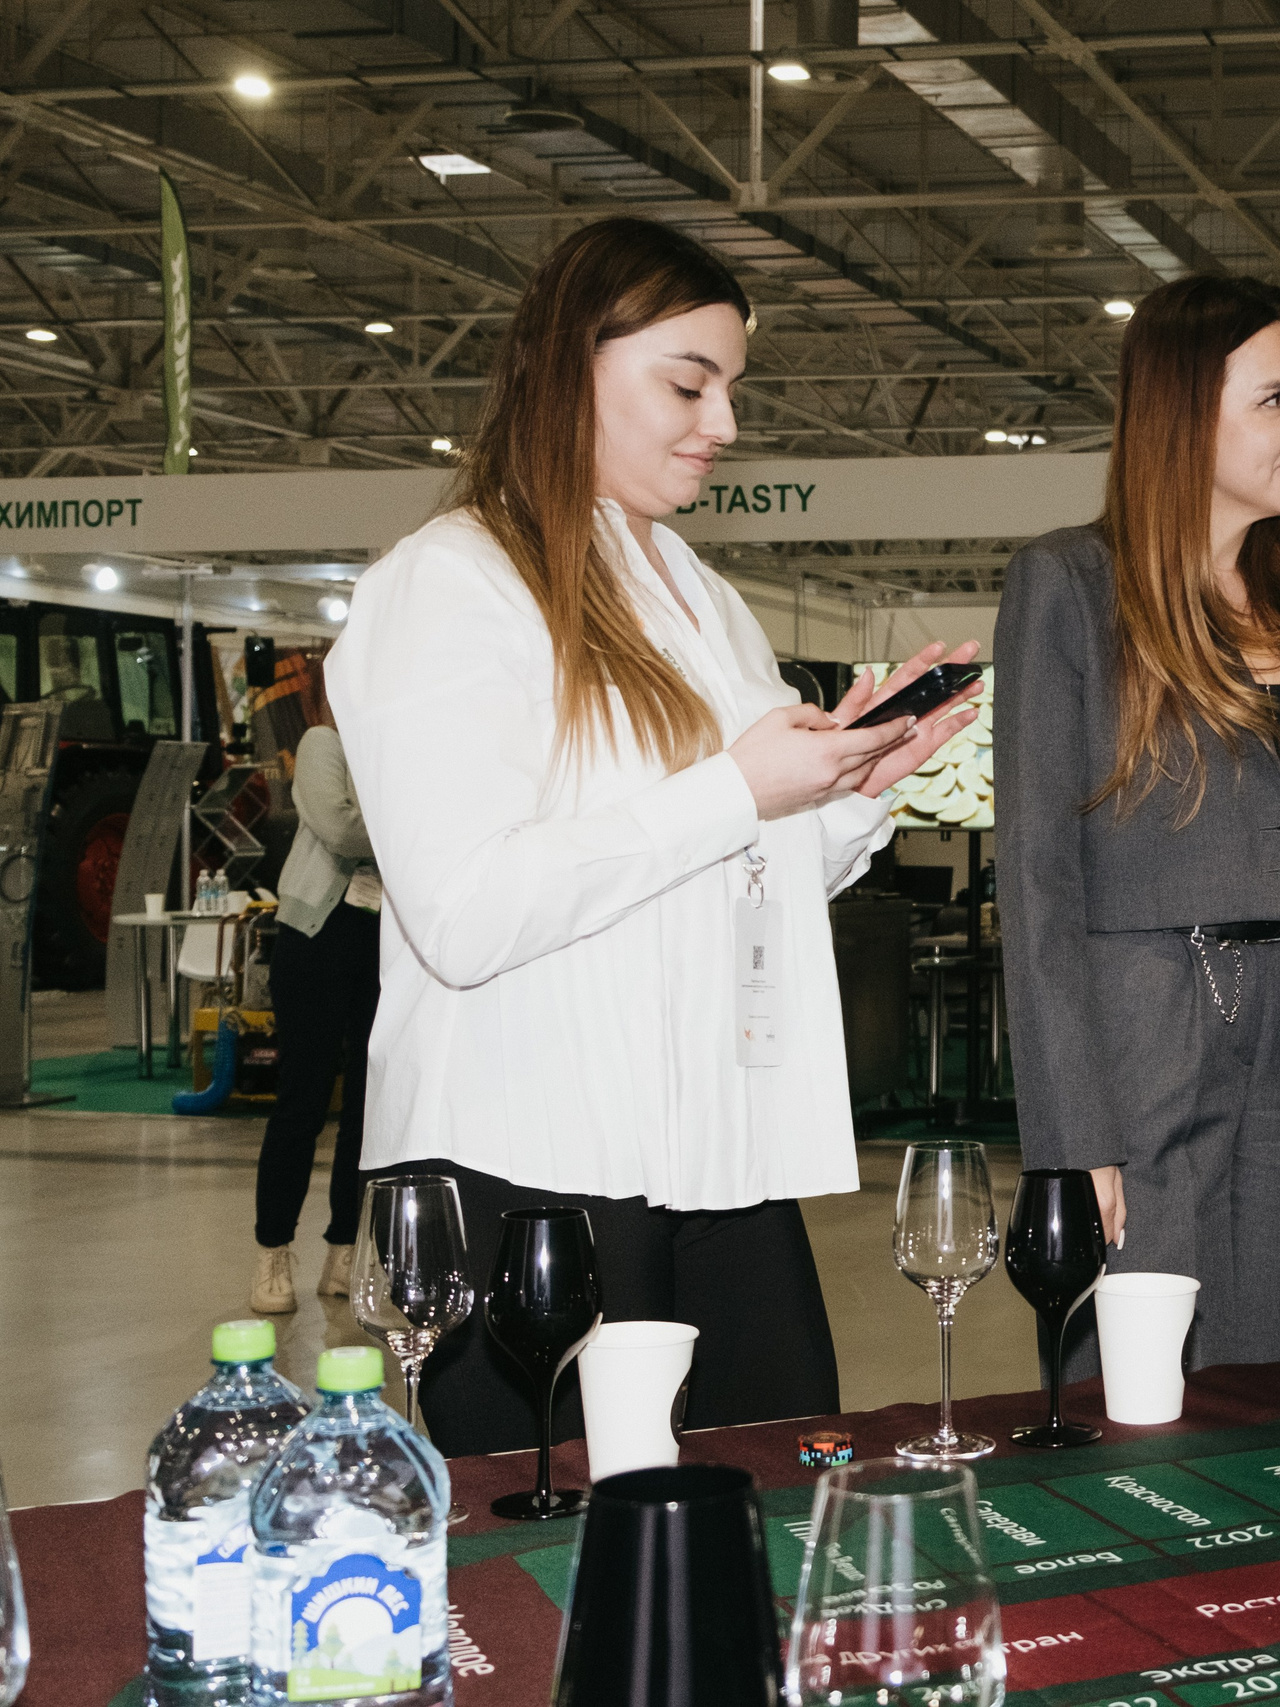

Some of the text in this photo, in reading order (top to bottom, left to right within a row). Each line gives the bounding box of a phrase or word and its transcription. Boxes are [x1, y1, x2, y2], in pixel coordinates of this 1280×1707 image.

[1104, 1474, 1211, 1527] Красностоп
[976, 1500, 1046, 1547] Саперави
[1186, 1524, 1274, 1549] 2022
[1014, 1551, 1124, 1575] Белое
[1140, 1651, 1279, 1684] Экстра
